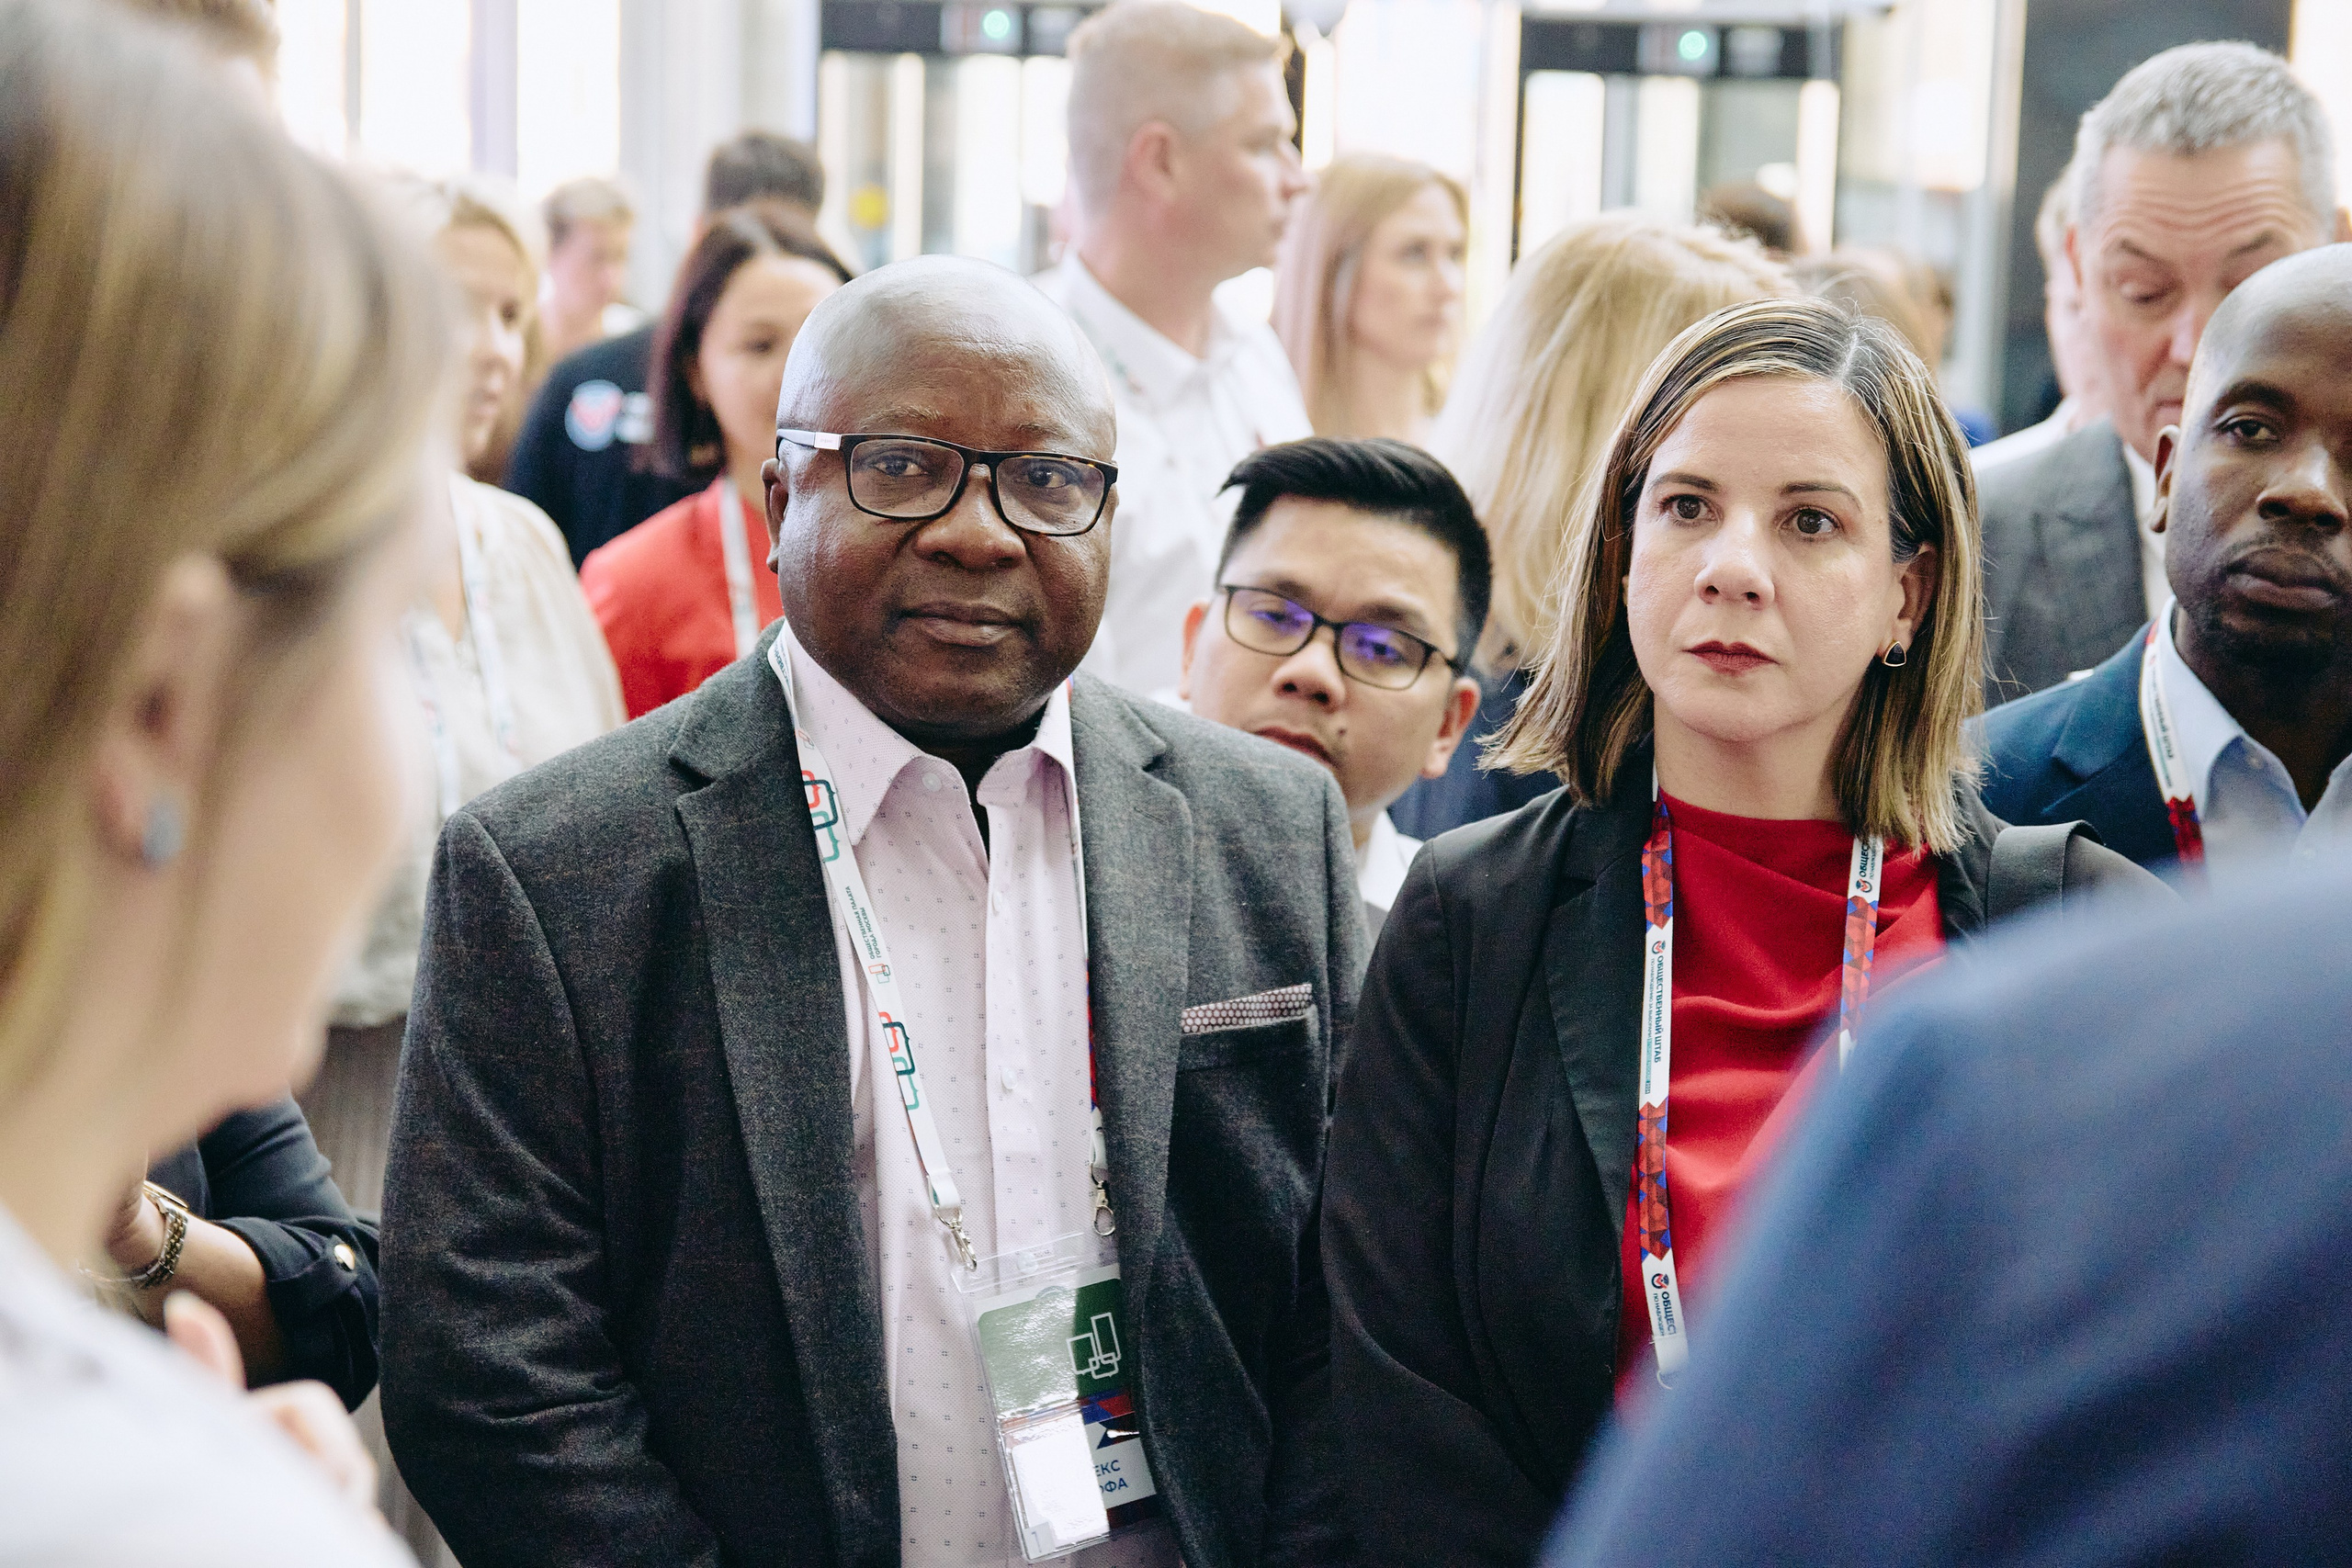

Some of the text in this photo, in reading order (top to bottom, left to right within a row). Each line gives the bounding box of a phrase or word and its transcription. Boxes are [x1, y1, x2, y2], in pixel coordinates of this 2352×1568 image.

[846, 886, 875, 959] ОБЩЕСТВЕННАЯ ПАЛАТА
[860, 908, 882, 958] ГОРОДА МОСКВЫ
[1654, 955, 1664, 1063] ОБЩЕСТВЕННЫЙ ШТАБ
[1653, 1292, 1659, 1303] ПО
[1093, 1460, 1121, 1477] ЕКС
